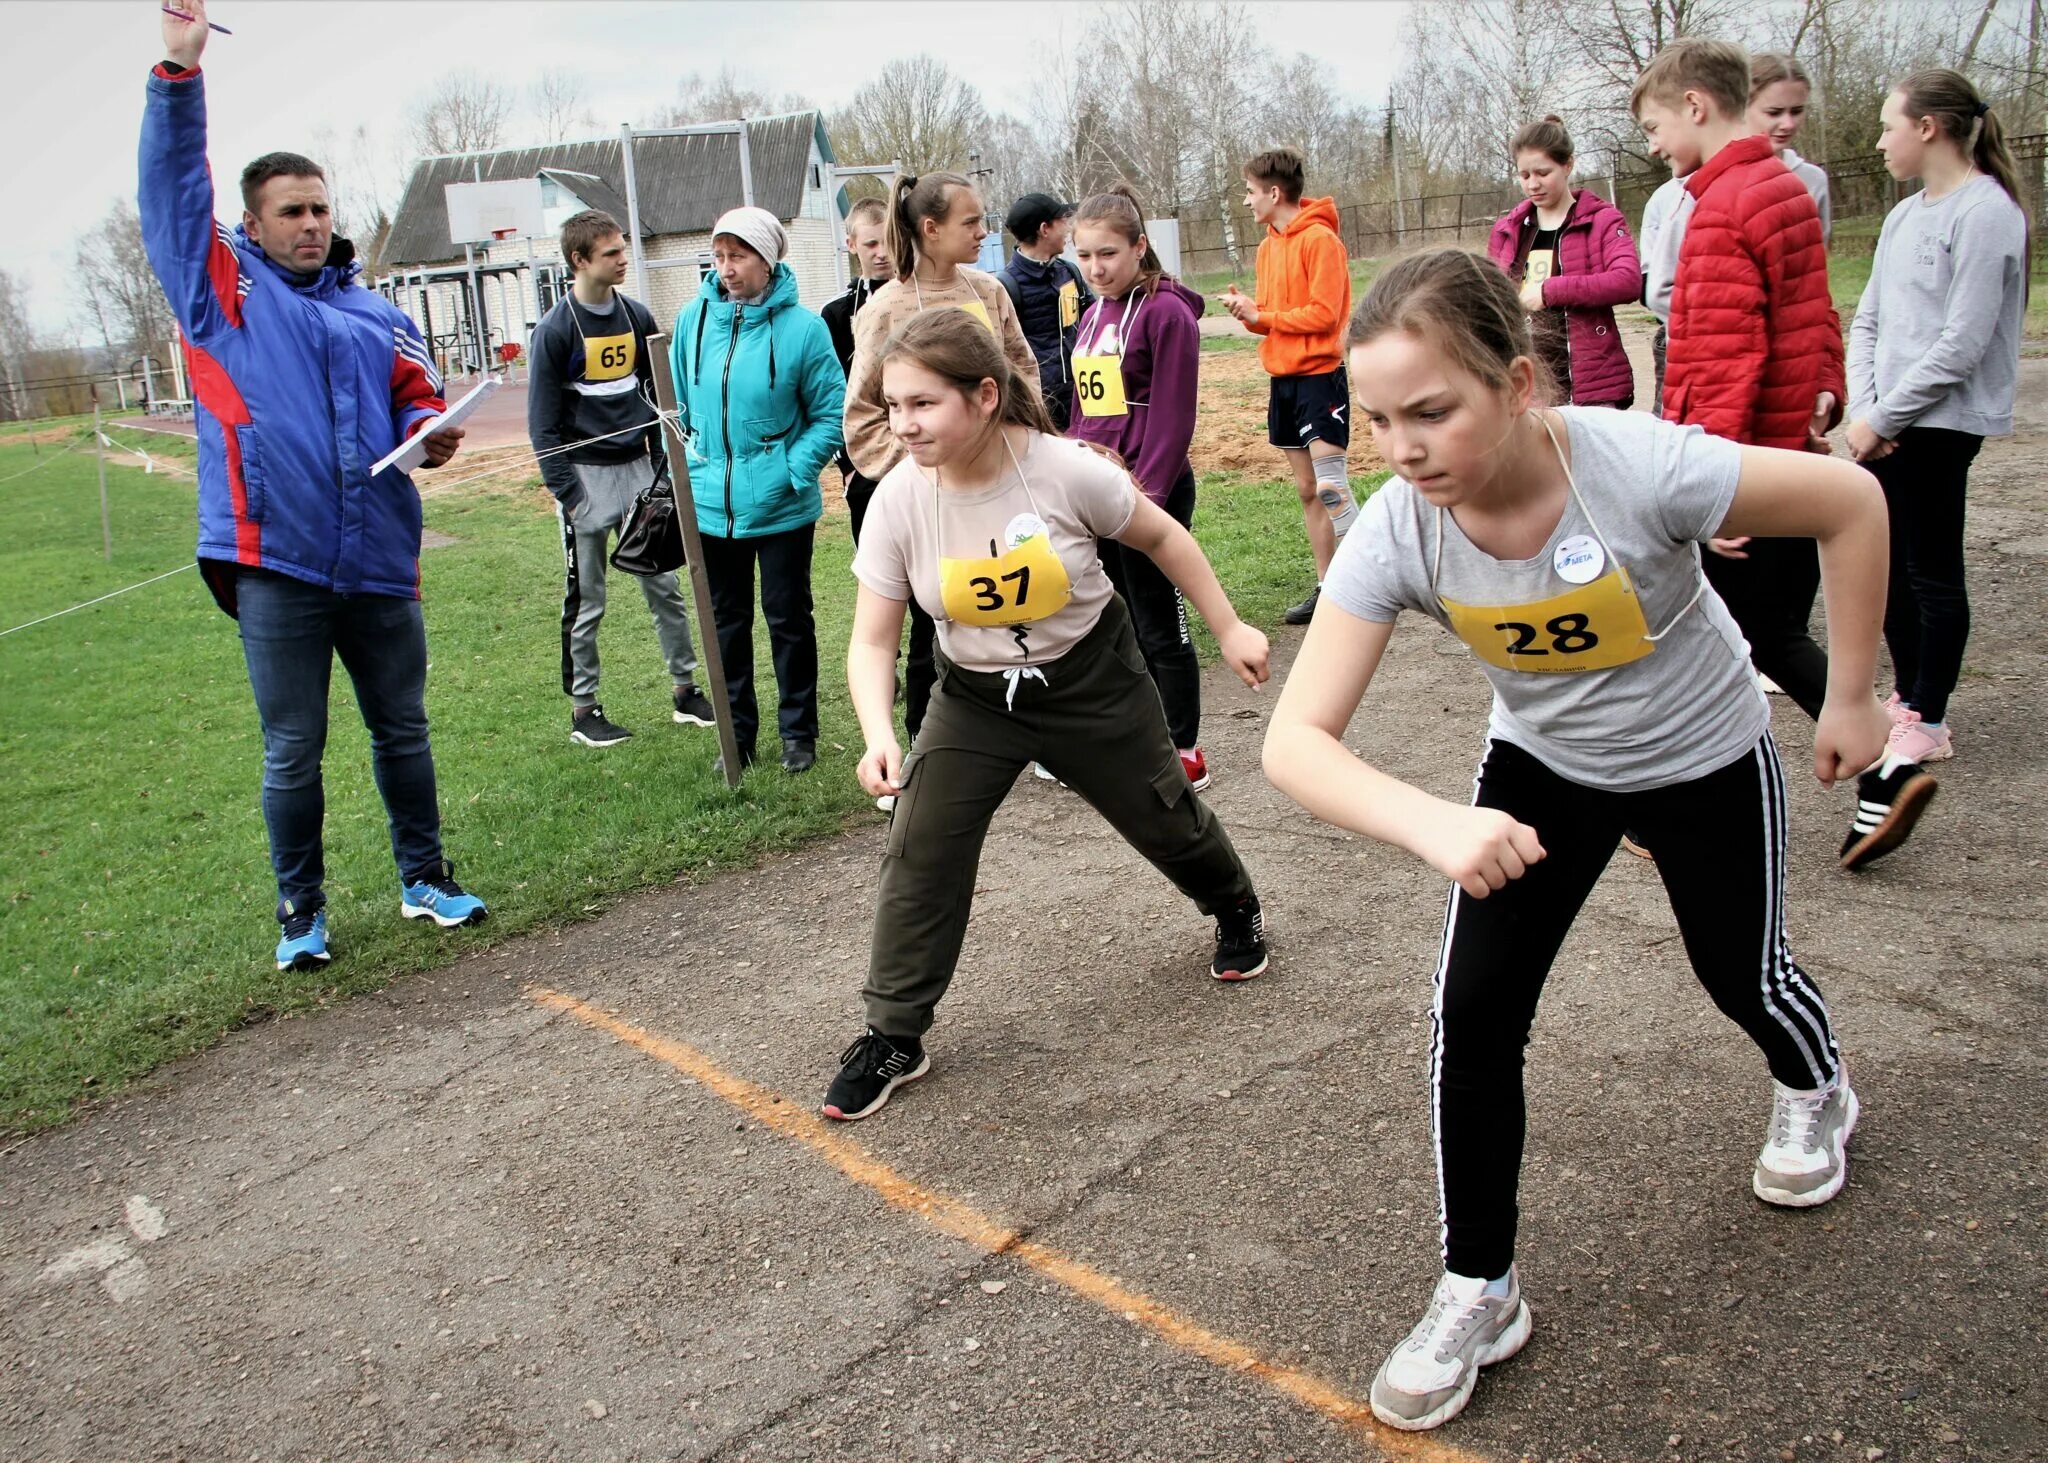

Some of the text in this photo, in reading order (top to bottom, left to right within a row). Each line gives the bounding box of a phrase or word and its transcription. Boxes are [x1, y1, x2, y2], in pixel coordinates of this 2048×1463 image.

[601, 344, 627, 369] 65
[1078, 370, 1105, 401] 66
[969, 565, 1030, 612] 37
[1494, 613, 1599, 656] 28
